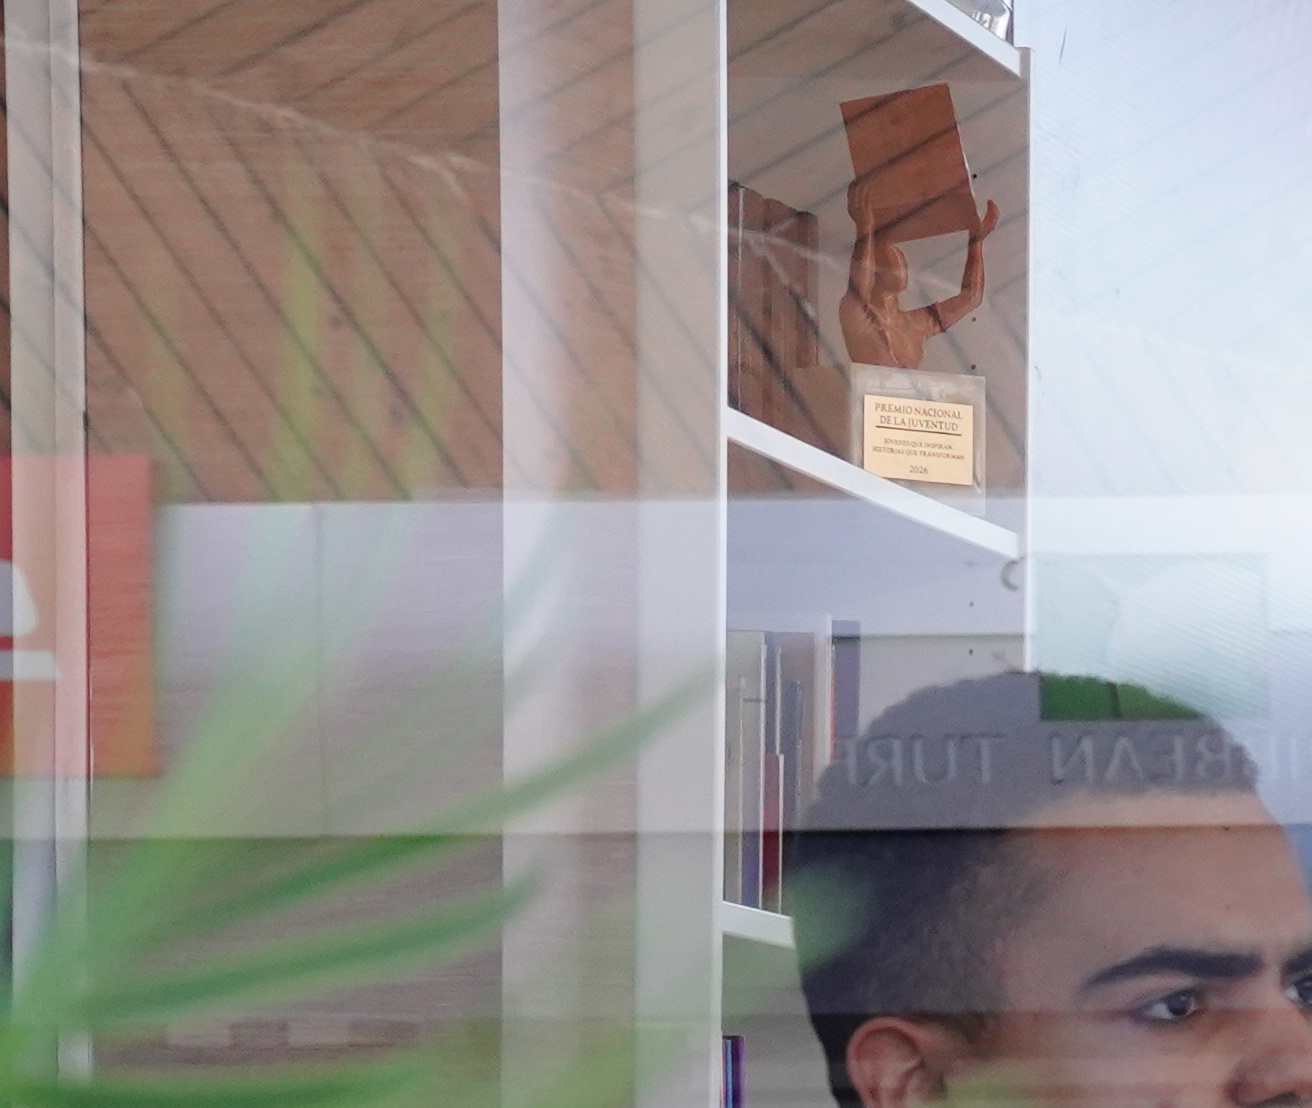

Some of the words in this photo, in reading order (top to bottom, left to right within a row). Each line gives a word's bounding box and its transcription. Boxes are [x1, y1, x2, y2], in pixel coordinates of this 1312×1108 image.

[874, 402, 913, 415] PREMIO
[914, 406, 963, 420] NACIONAL
[879, 415, 892, 425] DE
[893, 416, 906, 427] LA
[908, 417, 959, 432] JUVENTUD
[909, 465, 929, 475] 2026
